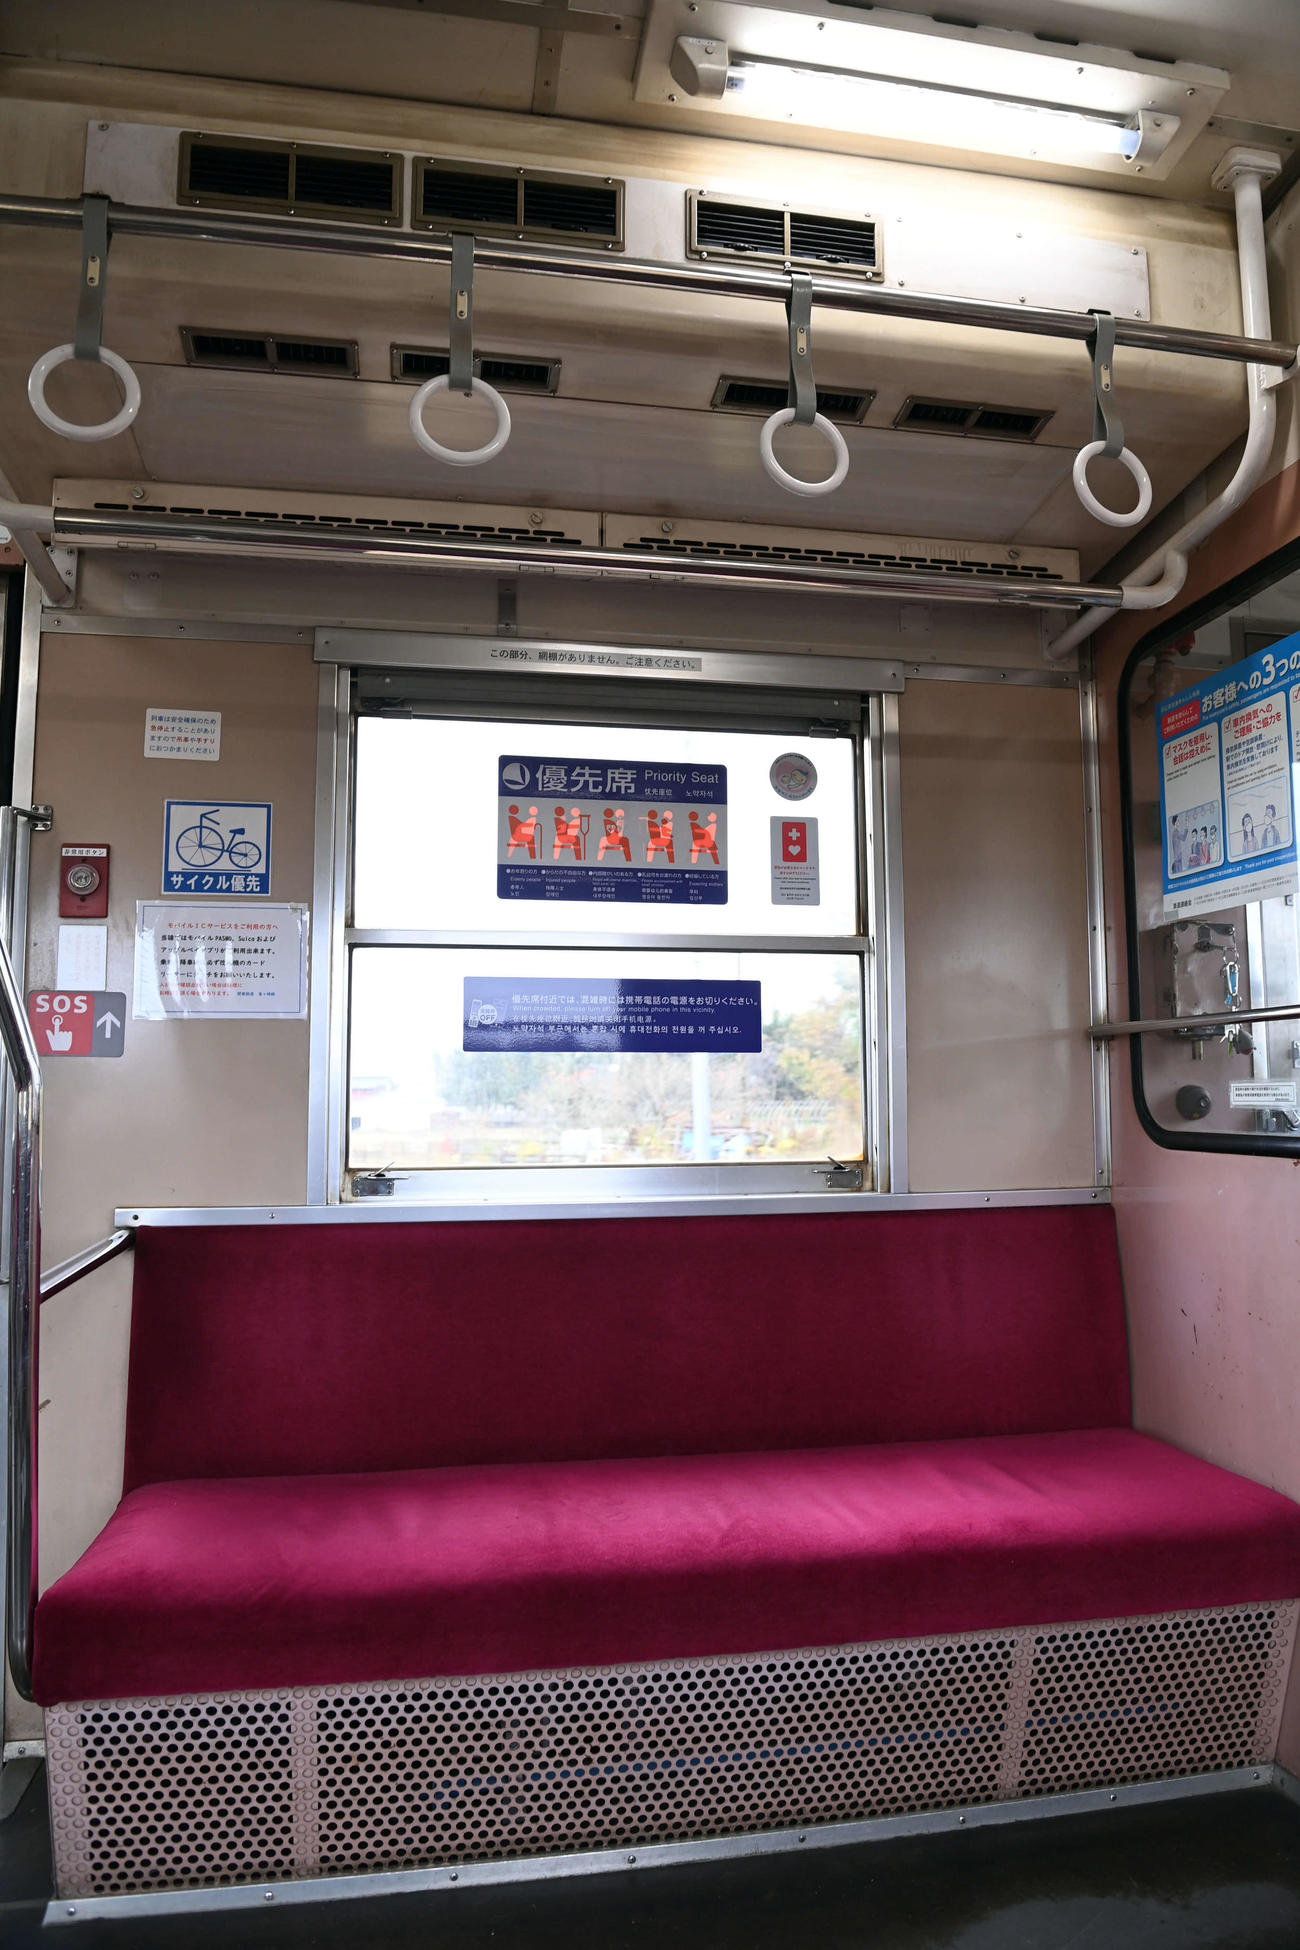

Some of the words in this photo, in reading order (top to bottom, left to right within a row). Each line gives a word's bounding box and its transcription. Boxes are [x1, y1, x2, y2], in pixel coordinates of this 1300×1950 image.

[535, 764, 638, 795] 優先席
[644, 769, 687, 784] Priority
[691, 771, 719, 784] Seat
[170, 874, 261, 892] サイクル優先
[35, 994, 88, 1014] SOS
[479, 1014, 496, 1022] OFF
[629, 1025, 669, 1034] 휴대전화의
[671, 1026, 695, 1034] 전원을
